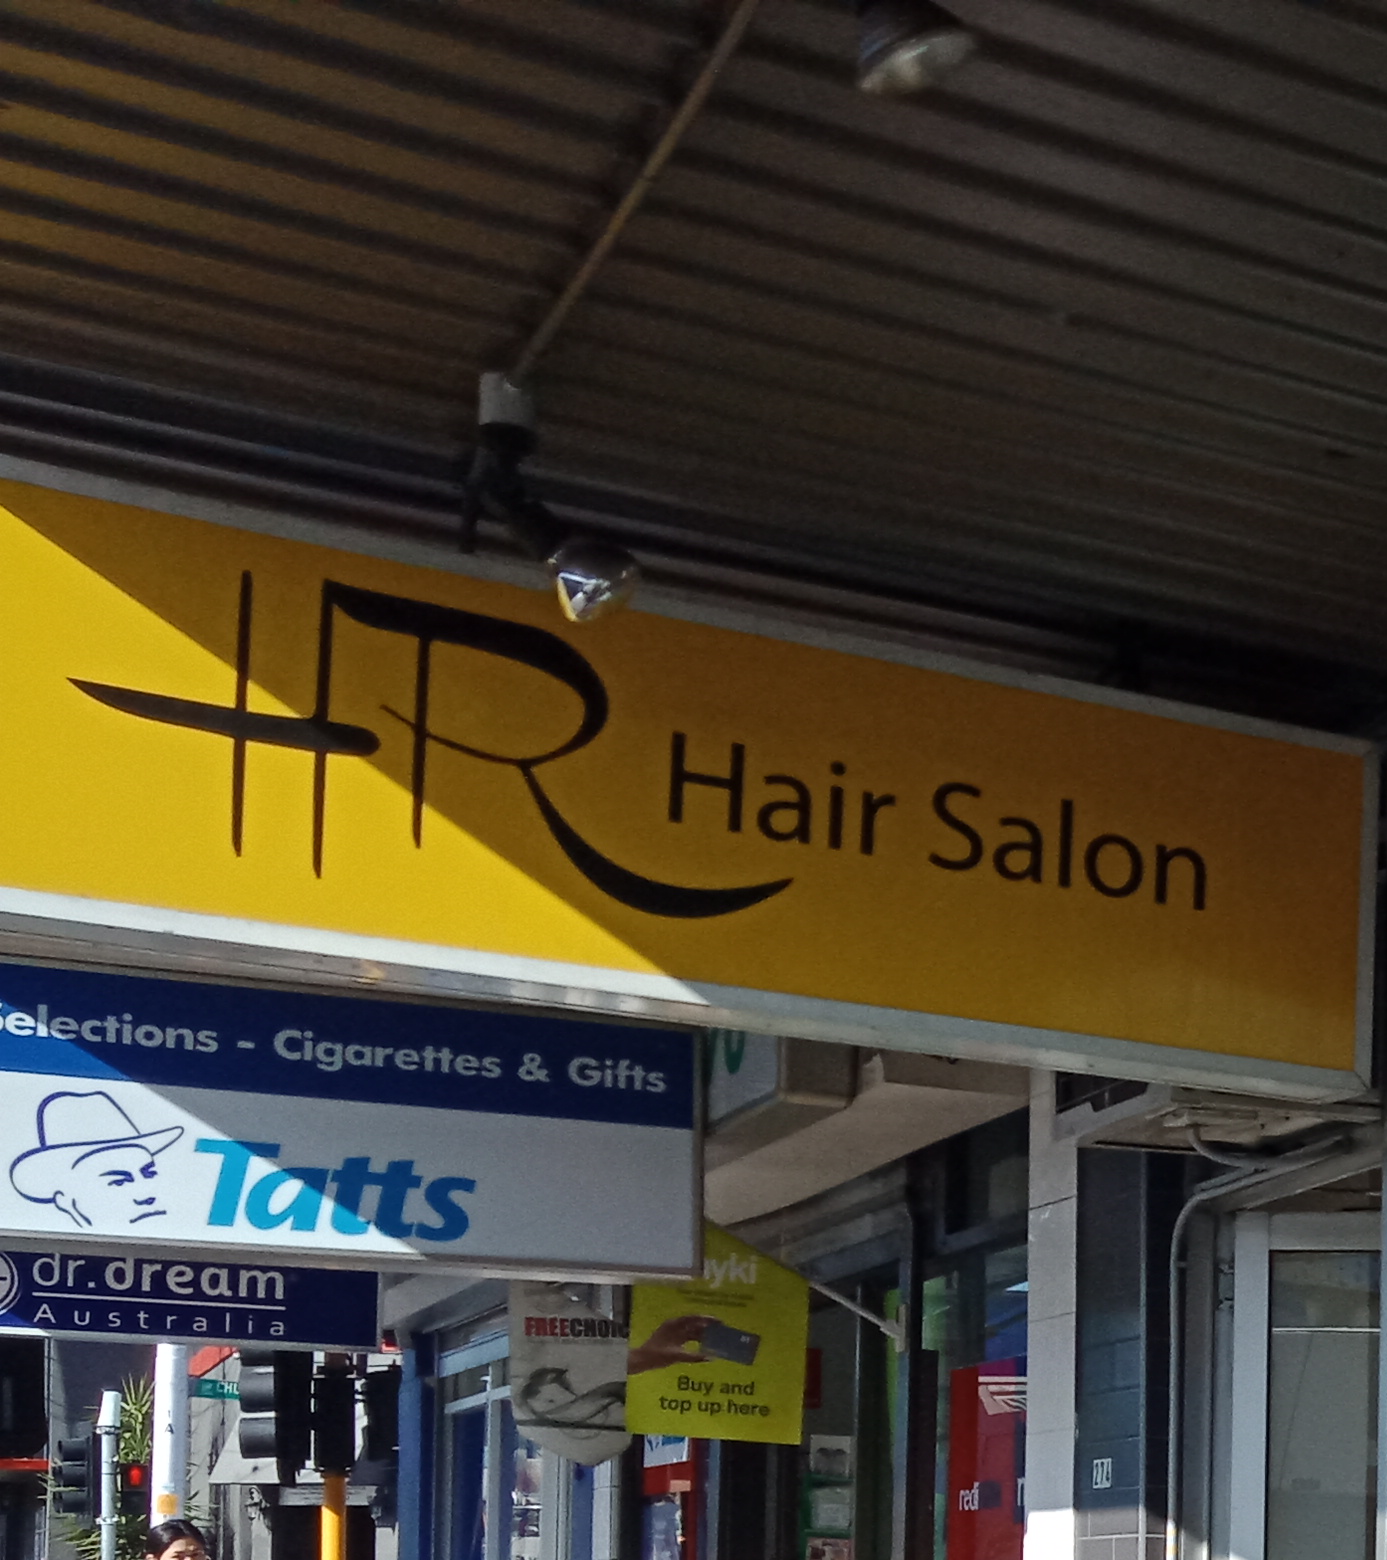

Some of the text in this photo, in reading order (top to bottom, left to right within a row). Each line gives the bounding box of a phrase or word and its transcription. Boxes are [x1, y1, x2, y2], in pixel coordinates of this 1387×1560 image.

[665, 731, 1210, 912] Hair Salon
[0, 1003, 219, 1053] elections
[274, 1029, 501, 1079] Cigarettes
[517, 1053, 550, 1083] &
[568, 1057, 668, 1093] Gifts
[194, 1137, 476, 1242] Tatts
[33, 1302, 286, 1336] Australia
[659, 1396, 771, 1417] top up here
[677, 1375, 755, 1397] Buy and
